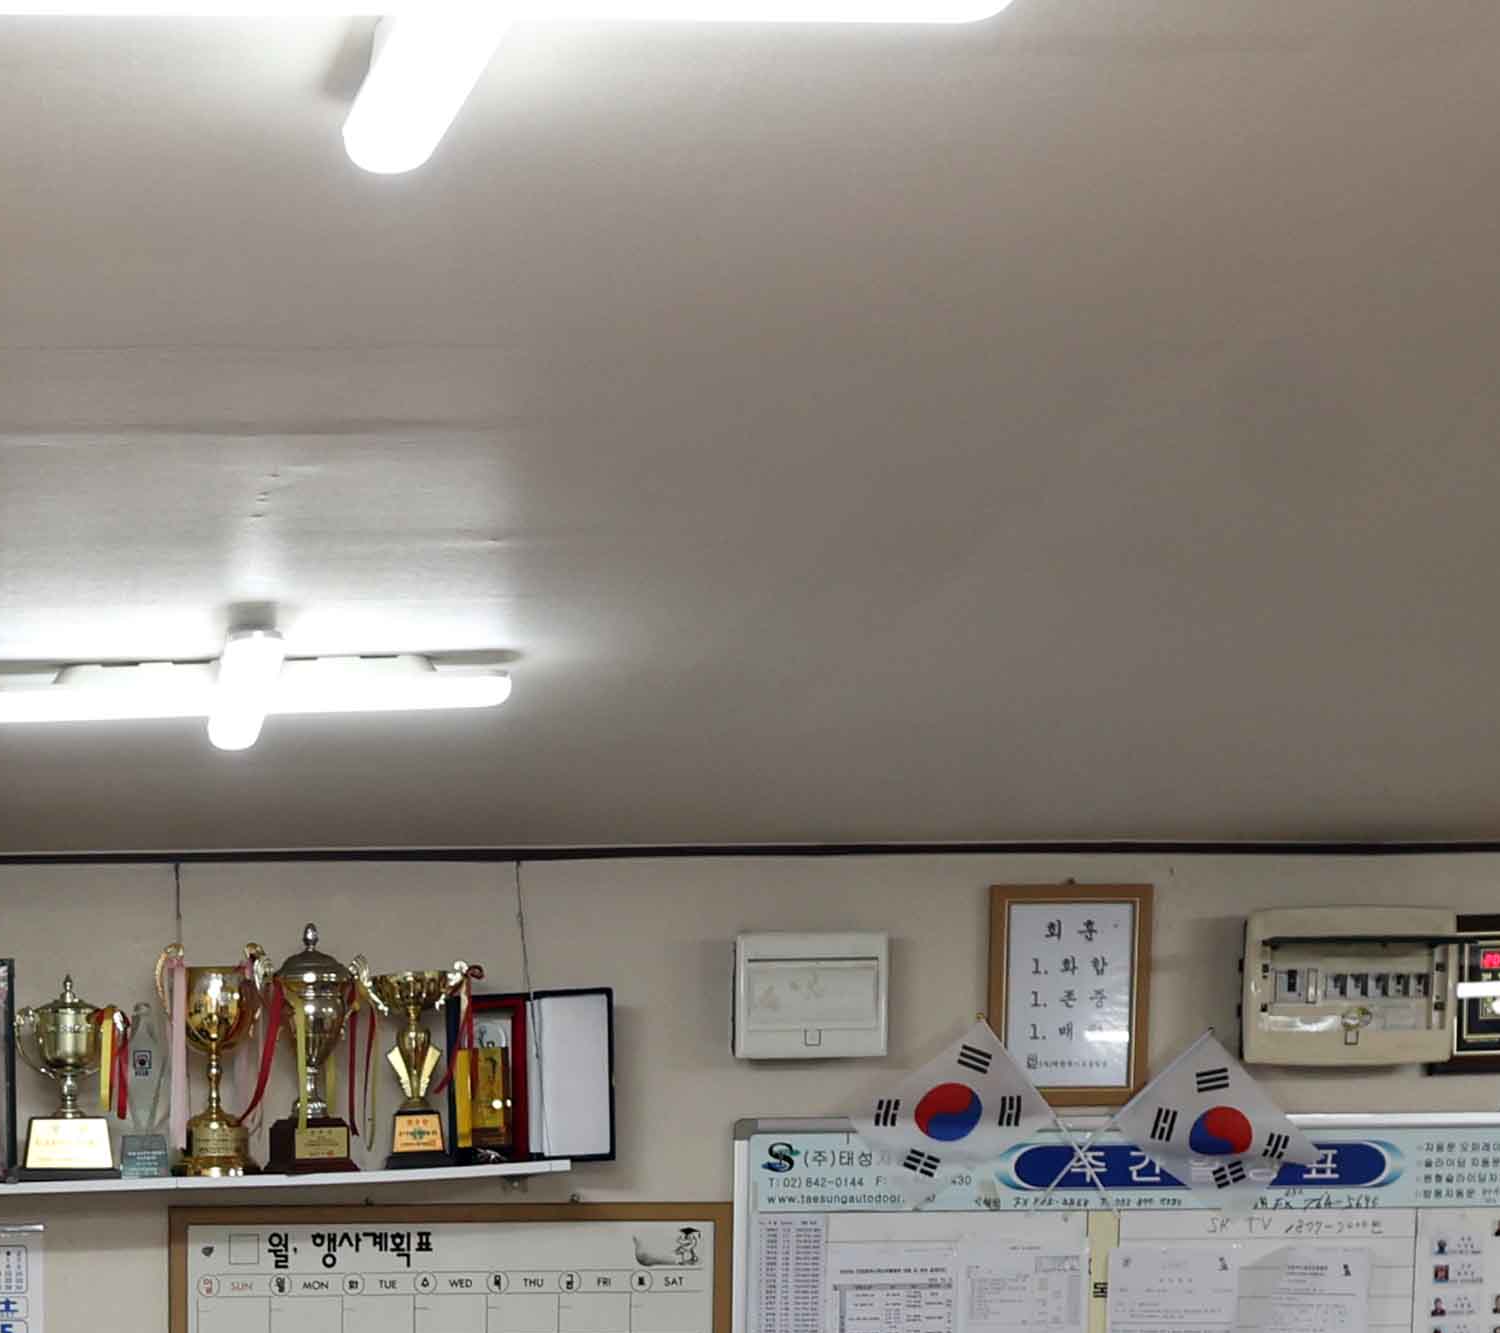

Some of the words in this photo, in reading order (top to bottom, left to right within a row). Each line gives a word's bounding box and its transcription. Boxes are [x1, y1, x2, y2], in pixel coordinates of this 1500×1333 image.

[1045, 919, 1062, 941] 회
[1077, 919, 1098, 942] 훈
[1032, 958, 1048, 975] 1.
[1060, 955, 1078, 975] 화
[1091, 955, 1108, 976] 합
[1031, 991, 1047, 1008] 1.
[1060, 989, 1077, 1008] 존
[1089, 988, 1107, 1008] 중
[1030, 1023, 1047, 1040] 1.
[1058, 1021, 1073, 1040] 배
[1070, 1151, 1107, 1183] 주
[1128, 1151, 1161, 1181] 간
[1302, 1150, 1340, 1180] 표
[312, 1231, 433, 1269] 행사계획표
[231, 1281, 253, 1291] SUN
[303, 1279, 329, 1290] MON
[379, 1279, 398, 1290] TUE
[448, 1278, 473, 1289] WED
[523, 1277, 544, 1288] THU
[597, 1277, 612, 1287] FRI
[664, 1276, 684, 1287] SAT
